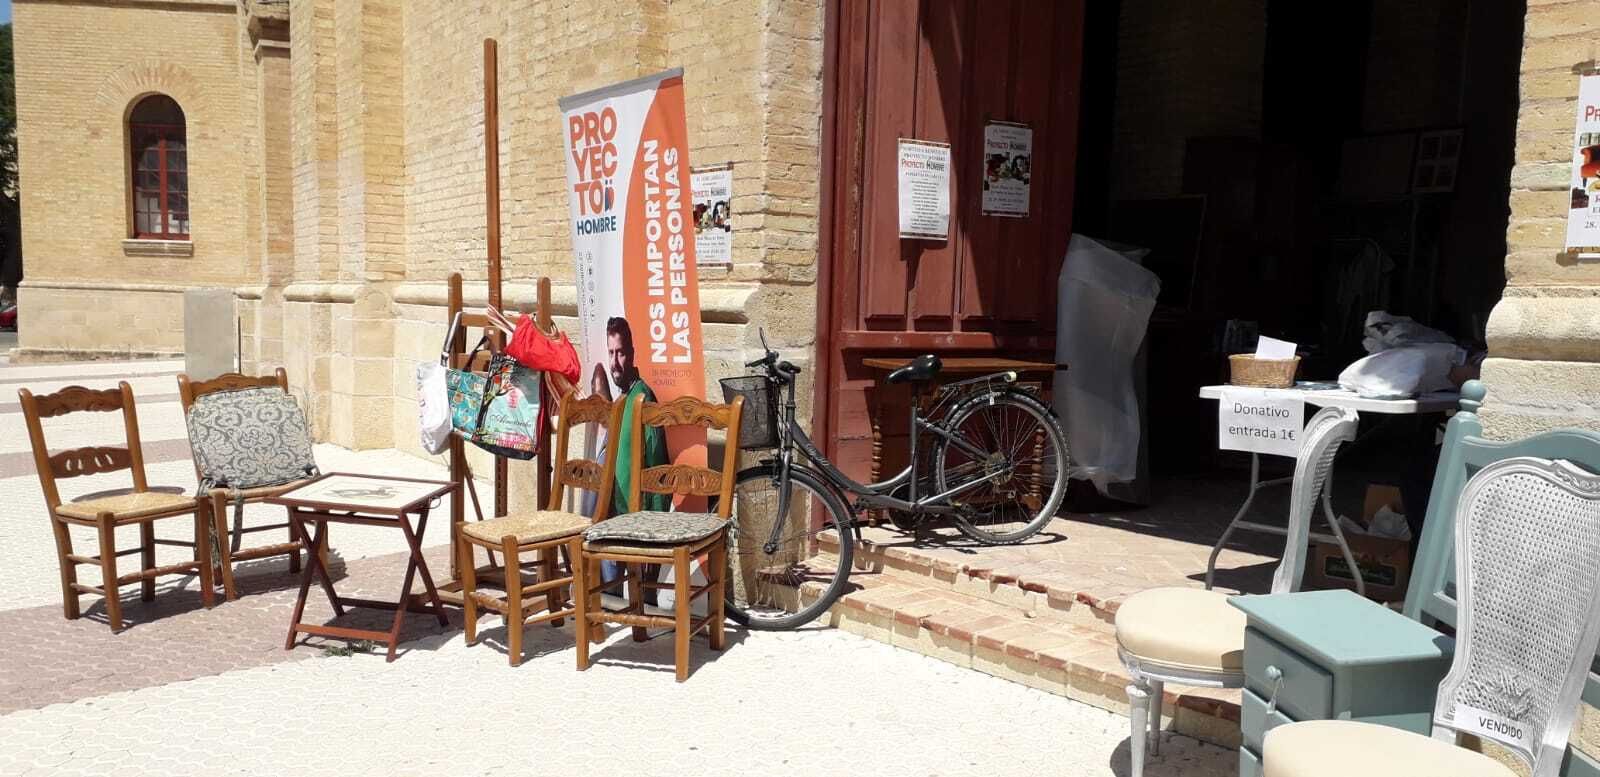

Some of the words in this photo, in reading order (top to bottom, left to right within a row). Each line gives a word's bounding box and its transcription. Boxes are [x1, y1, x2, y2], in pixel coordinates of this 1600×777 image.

[569, 106, 617, 149] PRO
[572, 142, 618, 182] YEC
[576, 215, 617, 236] HOMBRE
[643, 140, 665, 296] IMPORTAN
[663, 147, 688, 305] PERSONAS
[650, 302, 668, 363] NOS
[671, 311, 692, 363] LAS
[1234, 402, 1290, 418] Donativo
[1228, 425, 1277, 439] entrada
[1281, 429, 1296, 441] 1€
[1479, 717, 1523, 740] VENDIDO
